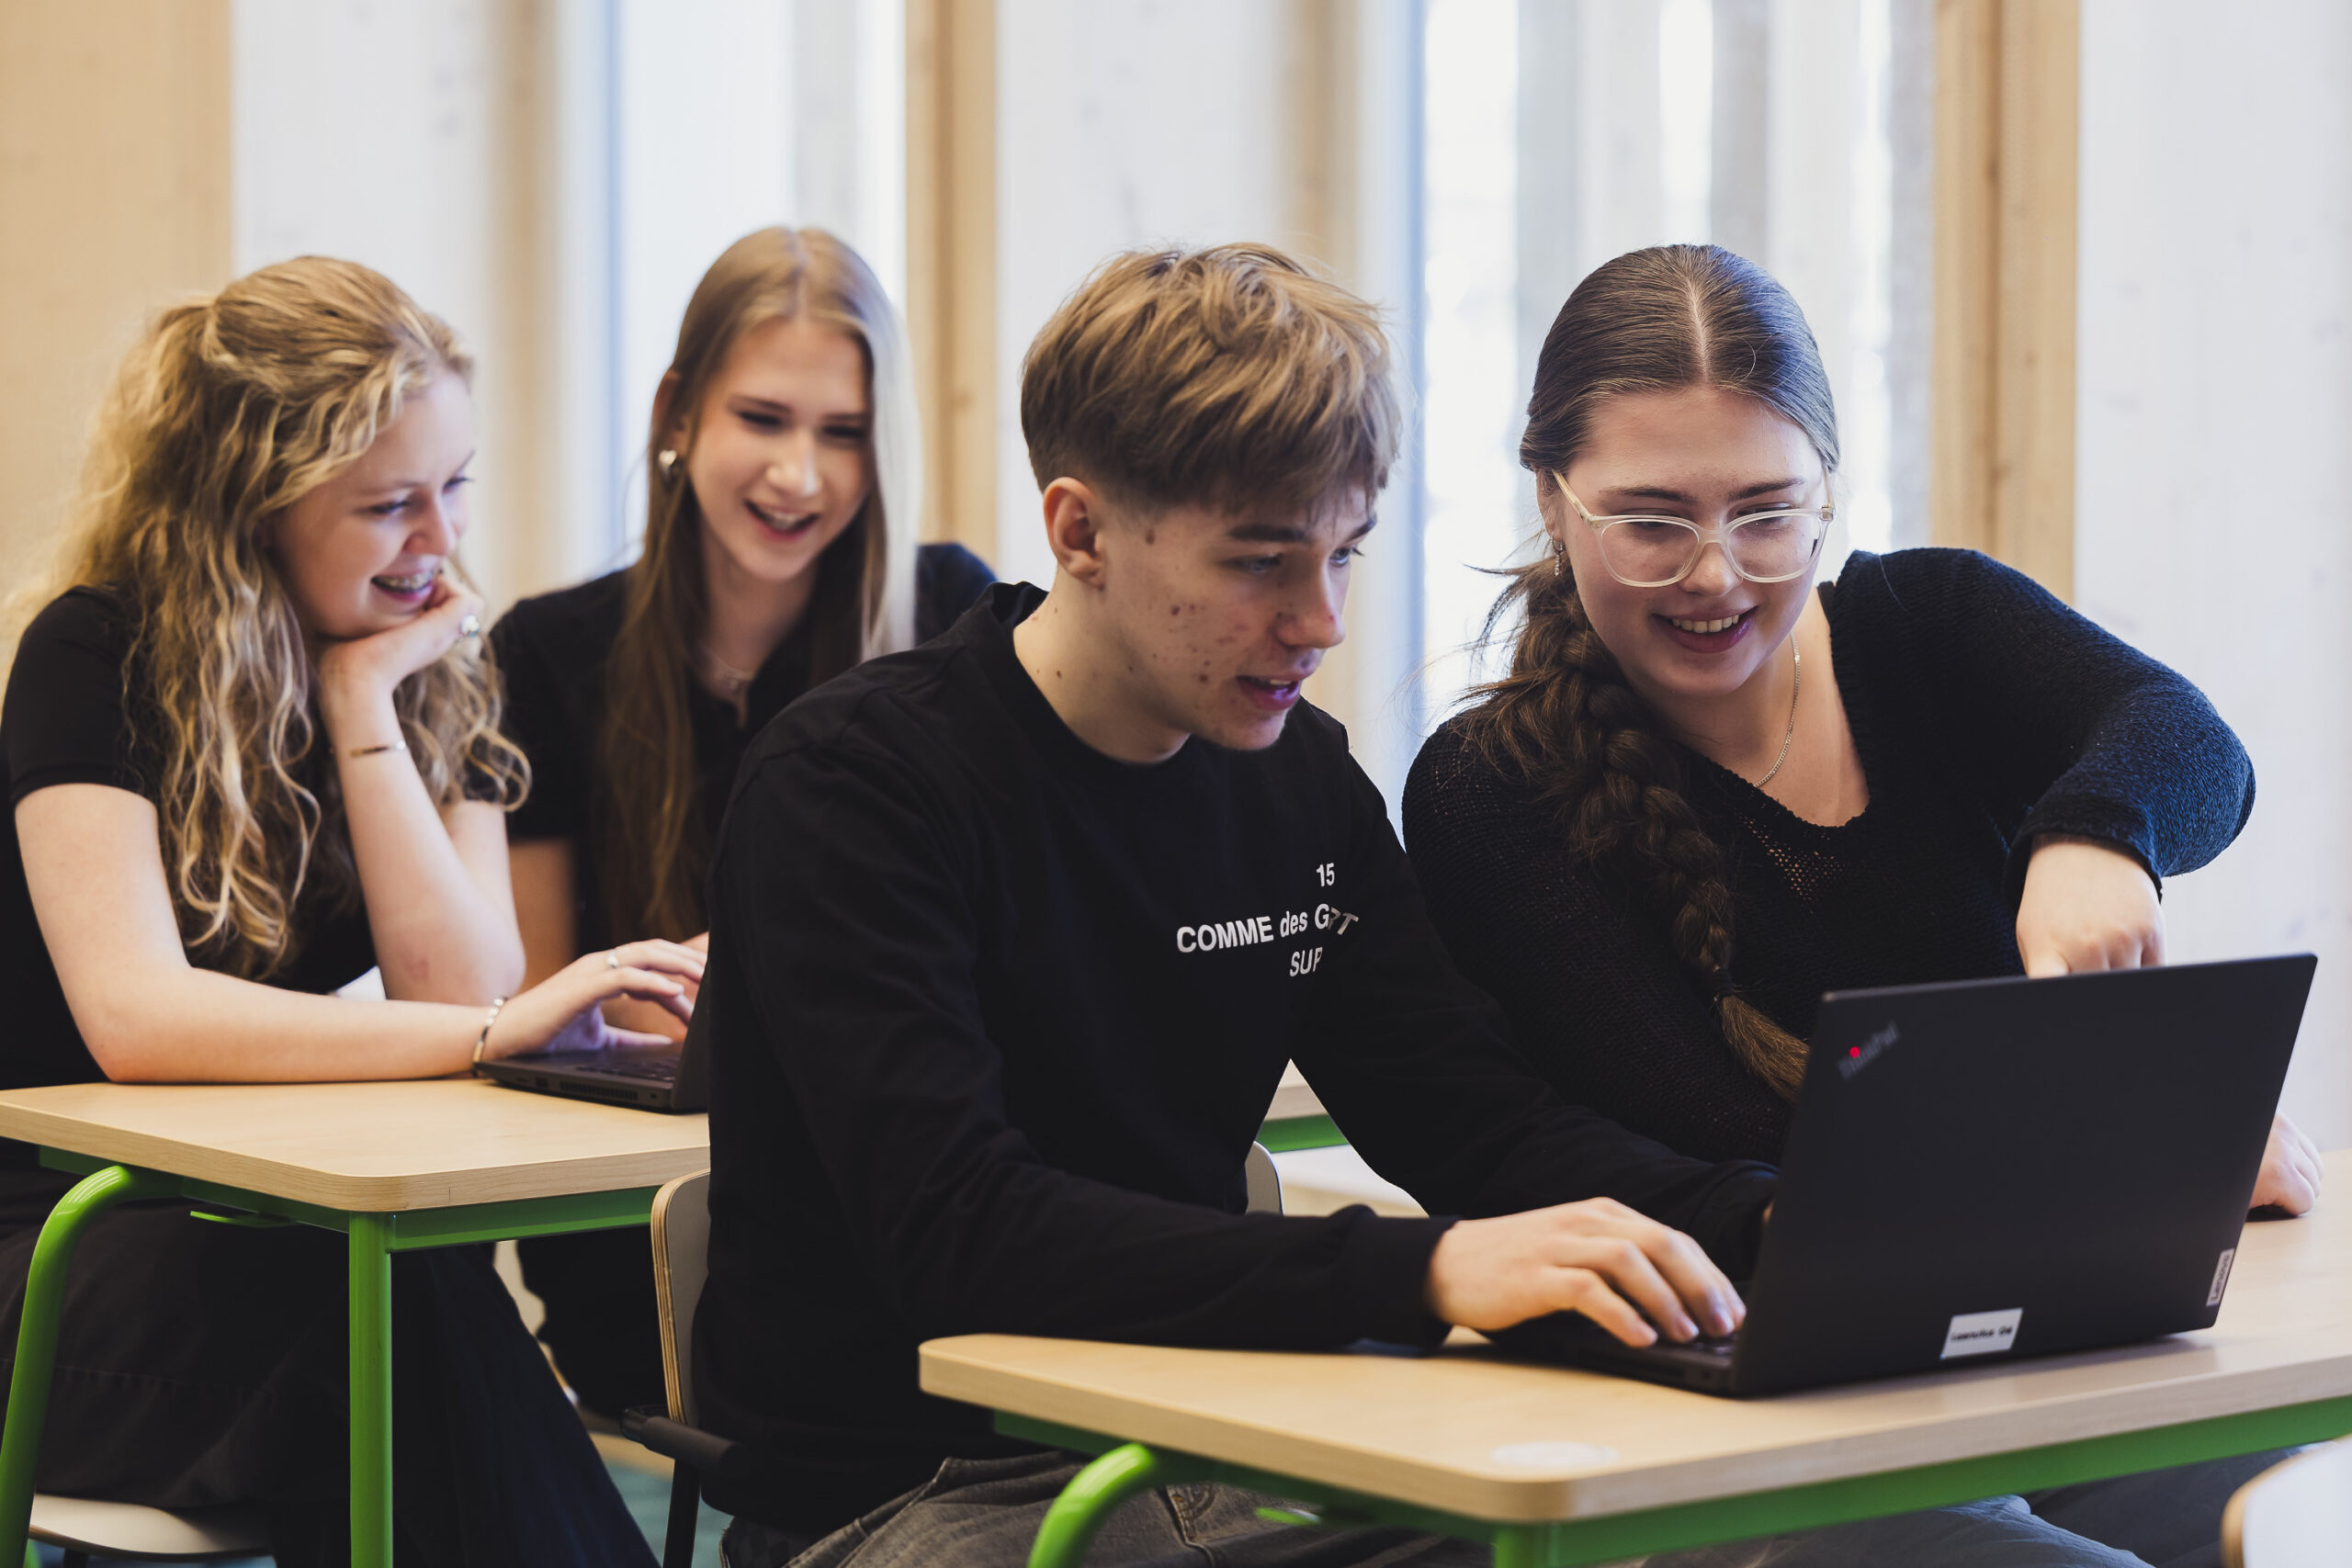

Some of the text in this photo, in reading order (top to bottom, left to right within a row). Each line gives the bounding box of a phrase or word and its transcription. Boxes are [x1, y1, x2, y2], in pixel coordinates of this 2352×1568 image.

[1316, 862, 1335, 887] 15
[1176, 916, 1274, 953] COMME
[1280, 910, 1308, 938] des
